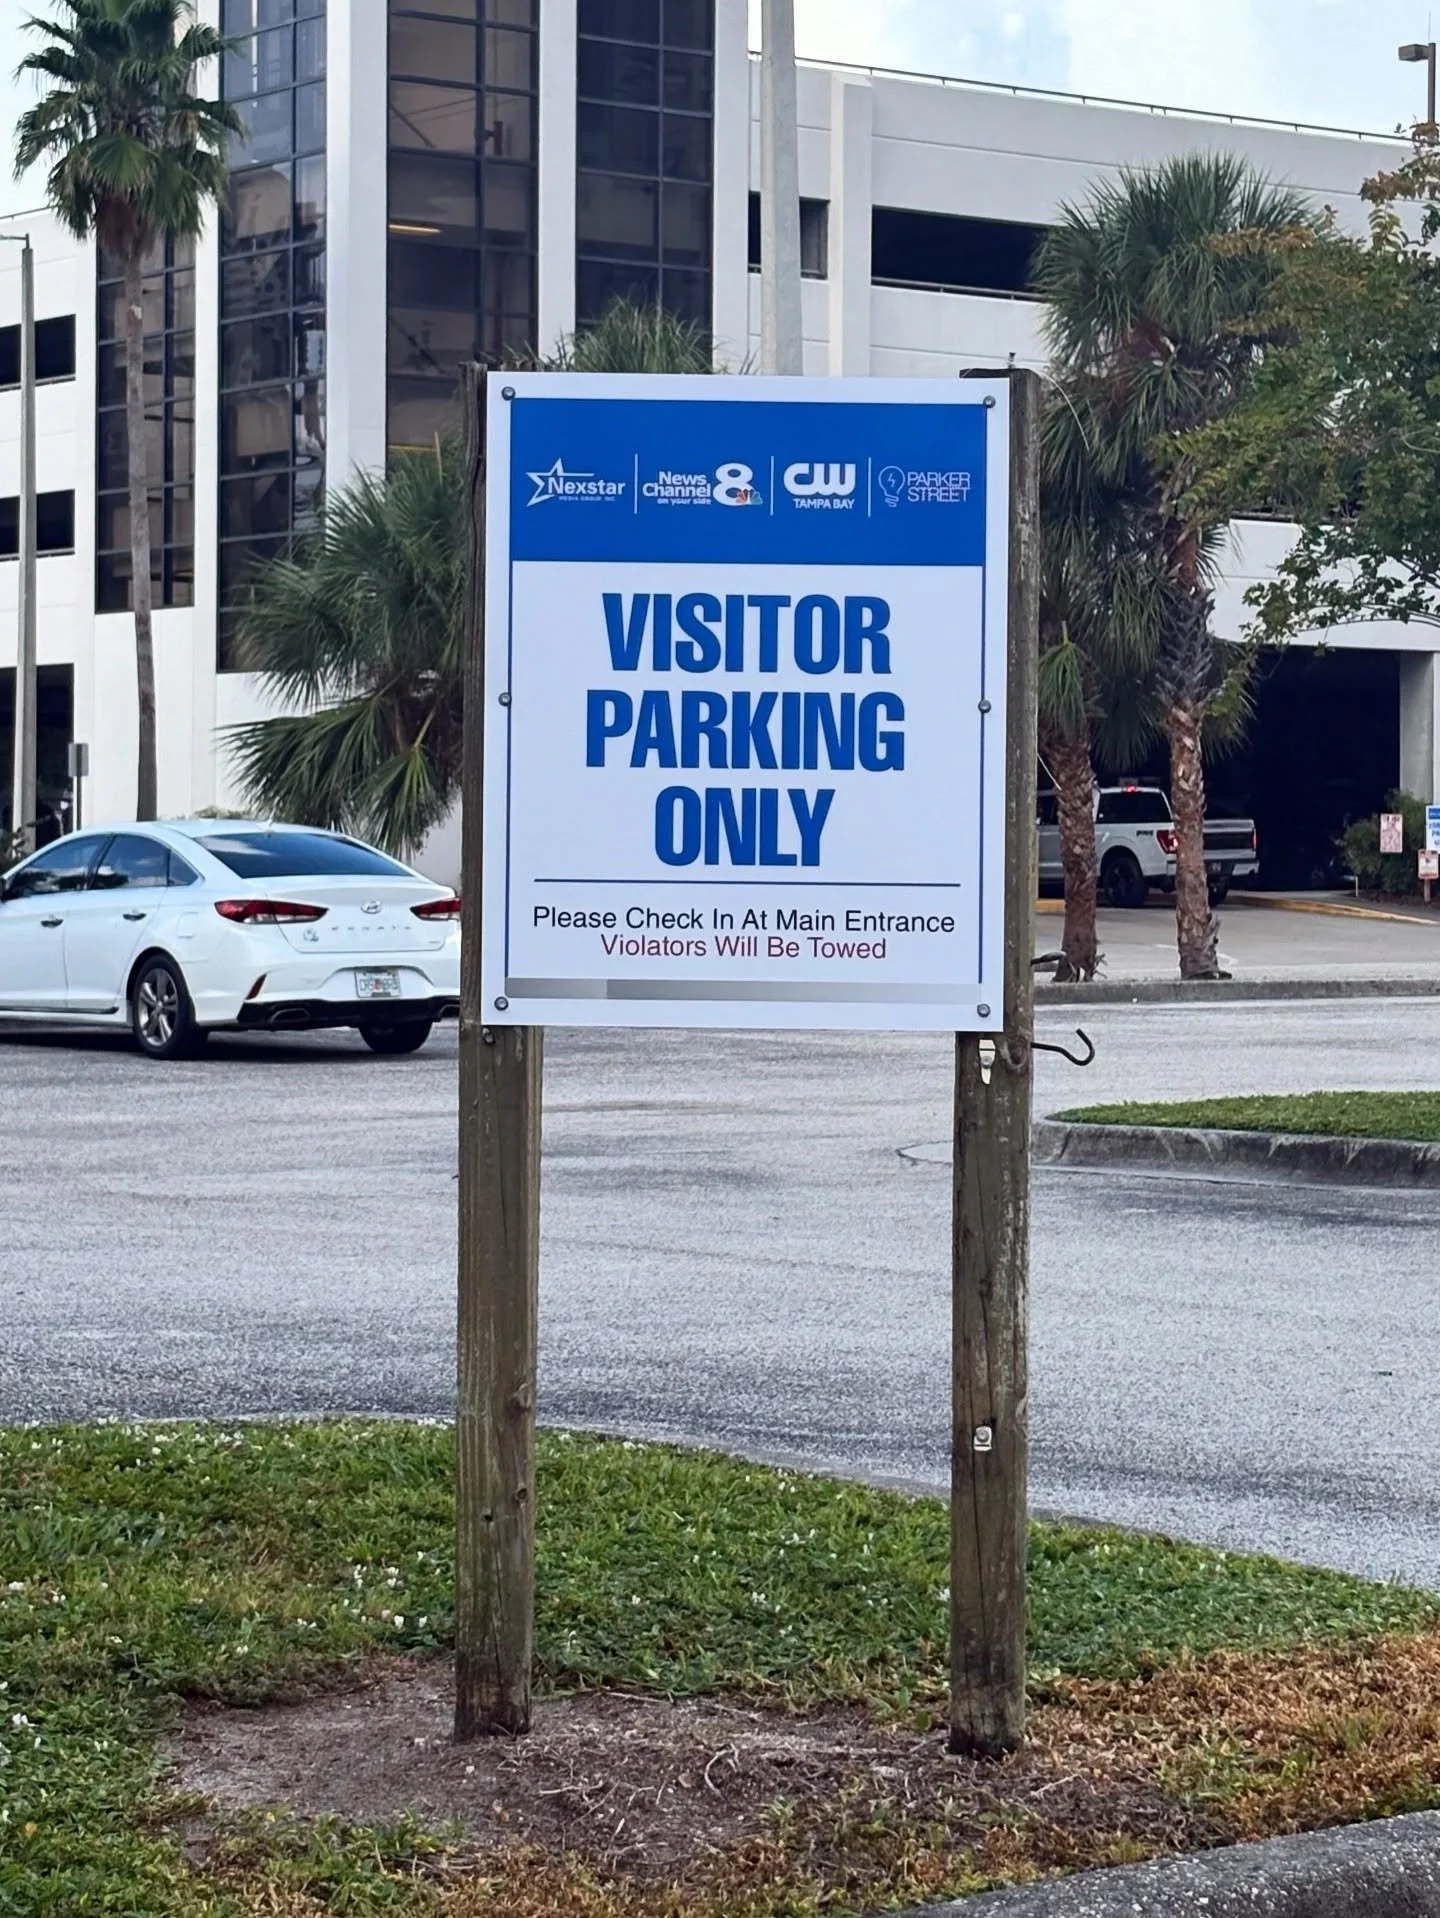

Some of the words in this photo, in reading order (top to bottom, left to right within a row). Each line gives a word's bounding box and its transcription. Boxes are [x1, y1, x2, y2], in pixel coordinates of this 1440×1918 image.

[548, 477, 626, 495] Nexstar
[658, 471, 707, 486] News
[712, 462, 755, 506] 8
[783, 462, 856, 496] CW
[907, 471, 971, 488] PARKER
[642, 482, 712, 497] Channel
[907, 487, 971, 503] STREET
[669, 498, 691, 506] your
[693, 497, 712, 505] side
[793, 498, 832, 509] TAMPA
[833, 498, 856, 509] BAY
[601, 592, 893, 675] VISITOR
[585, 689, 906, 772] PARKING
[654, 785, 836, 867] ONLY
[532, 906, 617, 929] Please
[625, 907, 703, 929] Check
[712, 908, 734, 930] In
[741, 908, 768, 930] At
[776, 909, 836, 931] Main
[845, 910, 956, 932] Entrance
[600, 934, 707, 957] Violators
[715, 934, 758, 957] Will
[767, 936, 800, 958] Be
[807, 936, 887, 959] Towed
